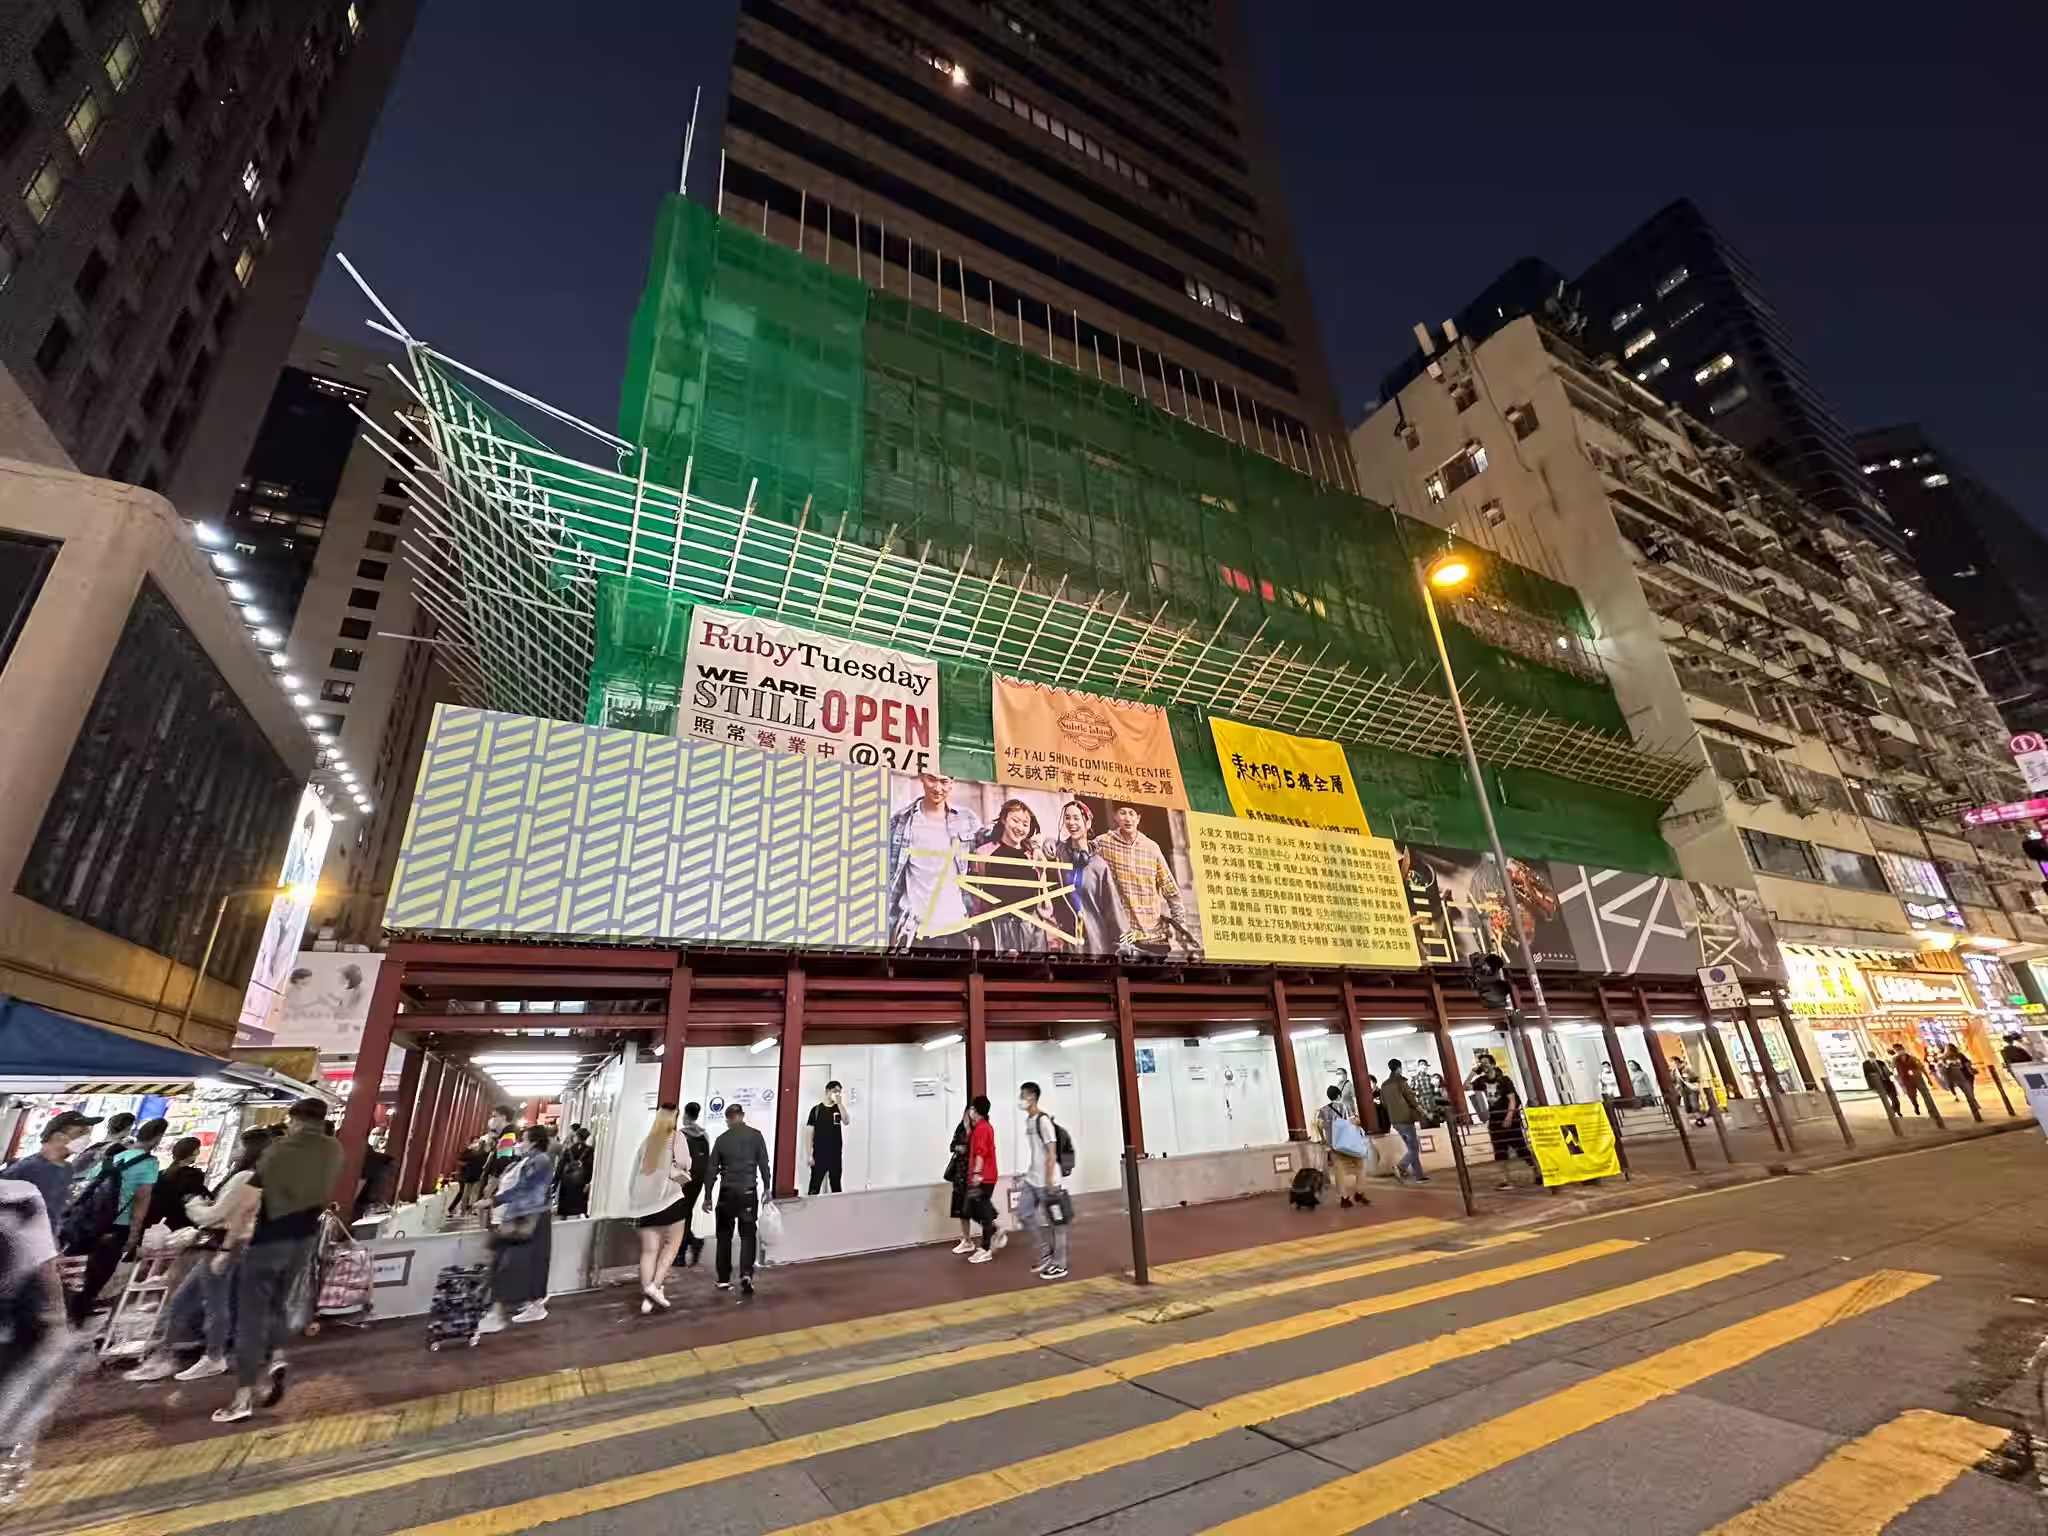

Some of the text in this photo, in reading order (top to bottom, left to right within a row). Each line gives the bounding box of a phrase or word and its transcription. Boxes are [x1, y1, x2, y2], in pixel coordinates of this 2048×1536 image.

[696, 665, 817, 699] WE ARE
[693, 680, 930, 748] STILL OPEN
[693, 716, 836, 759] 照常營業中
[1024, 749, 1046, 762] YAU
[1049, 752, 1078, 767] SHING
[1135, 767, 1173, 778] CENTRE
[1201, 841, 1217, 852] 旺角
